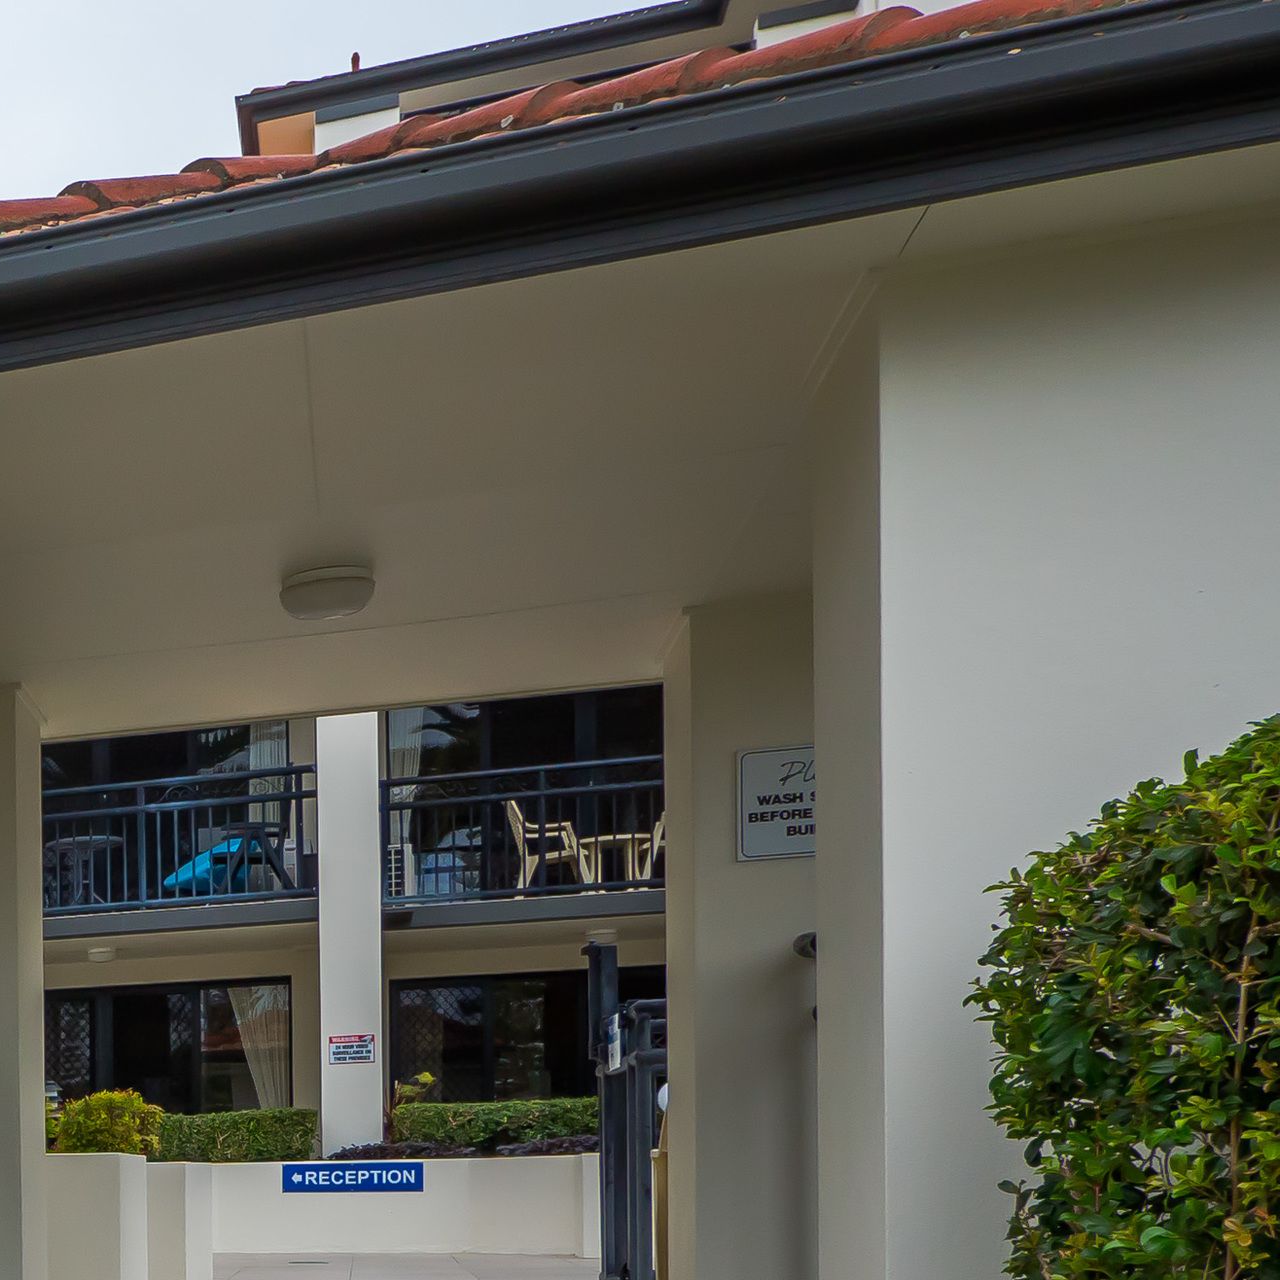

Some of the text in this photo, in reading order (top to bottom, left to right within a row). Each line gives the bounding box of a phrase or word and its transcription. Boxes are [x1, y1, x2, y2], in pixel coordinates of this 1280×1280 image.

[779, 760, 816, 787] Pl
[757, 792, 804, 806] WASH
[748, 808, 813, 823] BEFORE
[304, 1169, 416, 1185] RECEPTION
